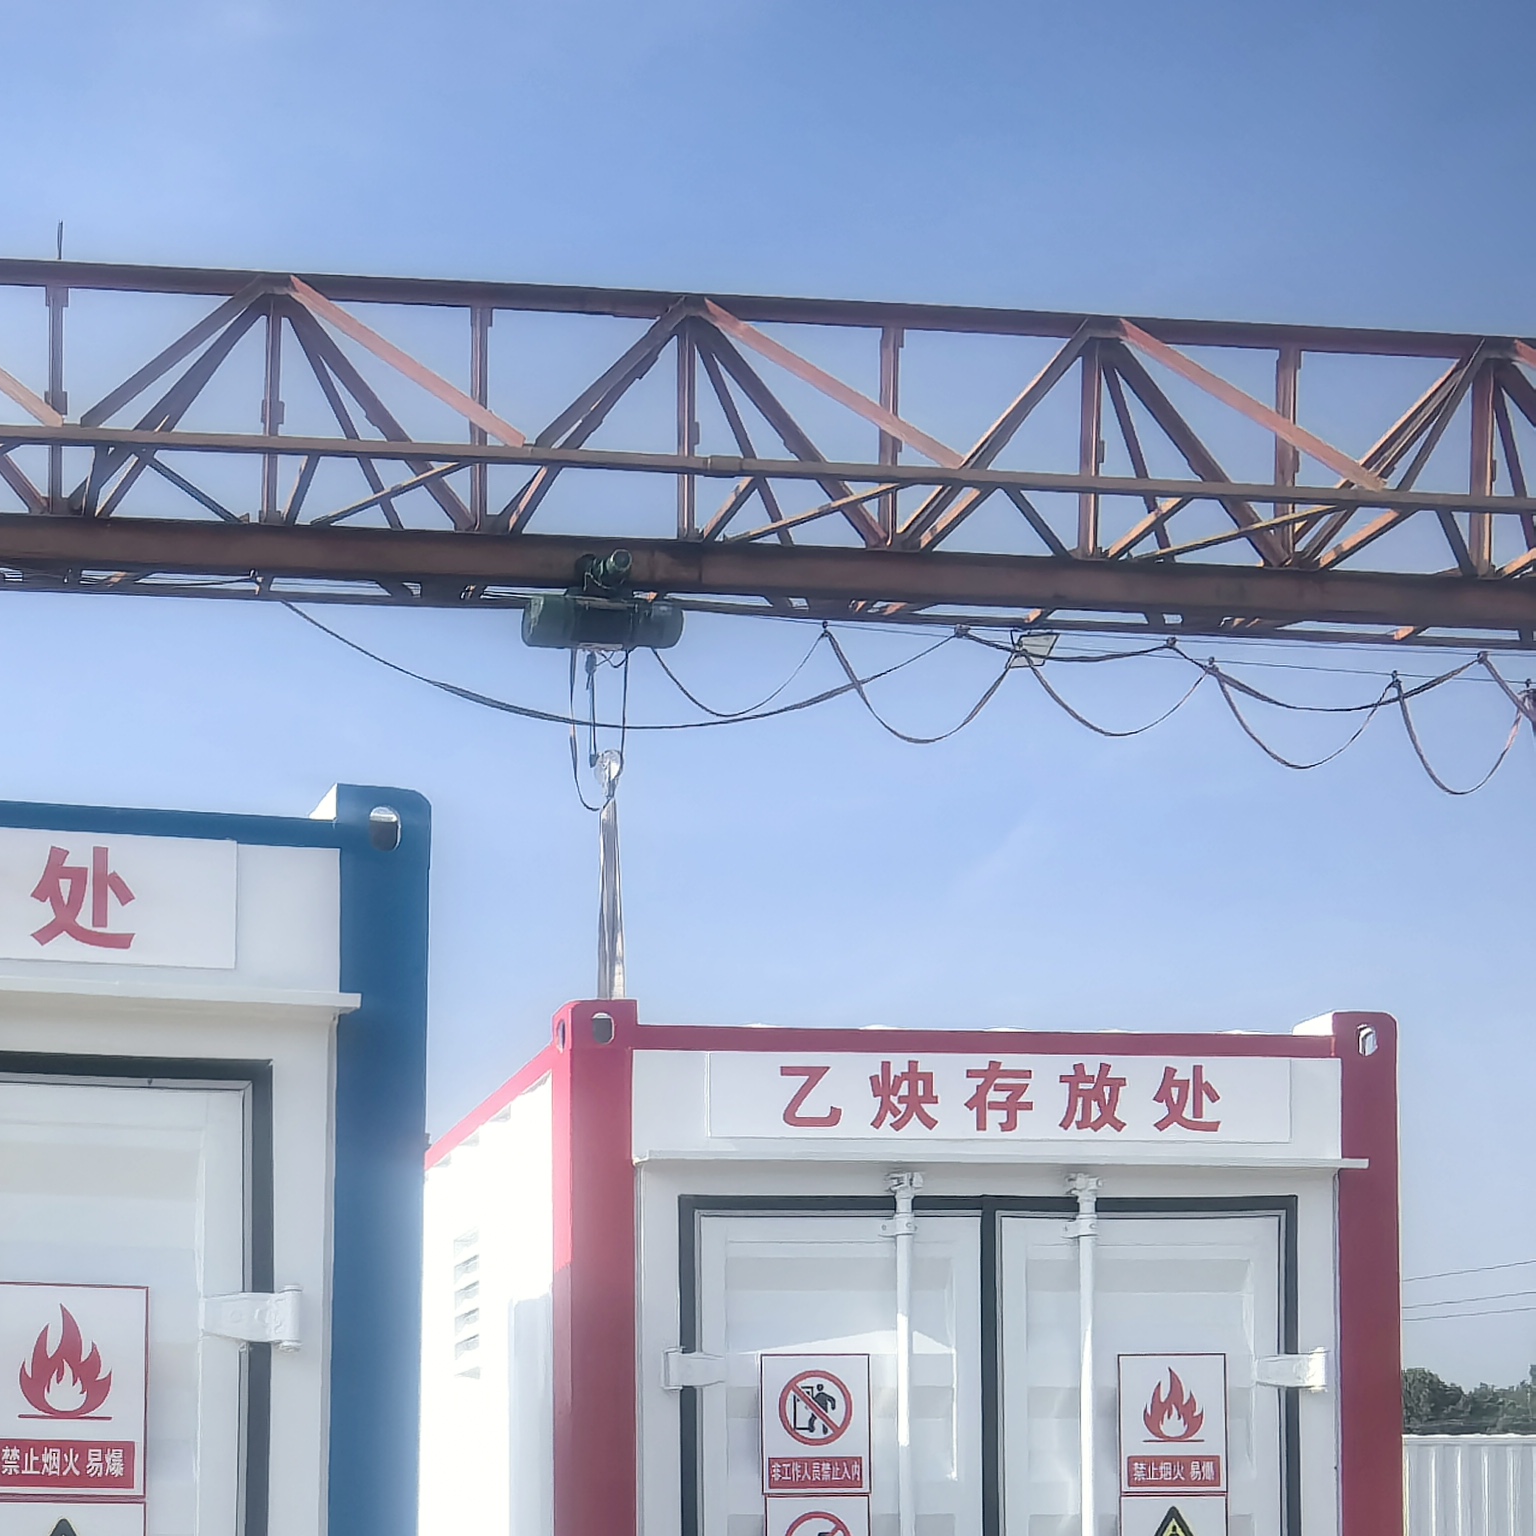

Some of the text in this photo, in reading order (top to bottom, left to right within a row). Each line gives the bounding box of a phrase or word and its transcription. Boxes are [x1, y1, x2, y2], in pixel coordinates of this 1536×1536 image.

[779, 1060, 1221, 1133] 乙炔存放处
[0, 1445, 125, 1478] 禁止烟火 易爆
